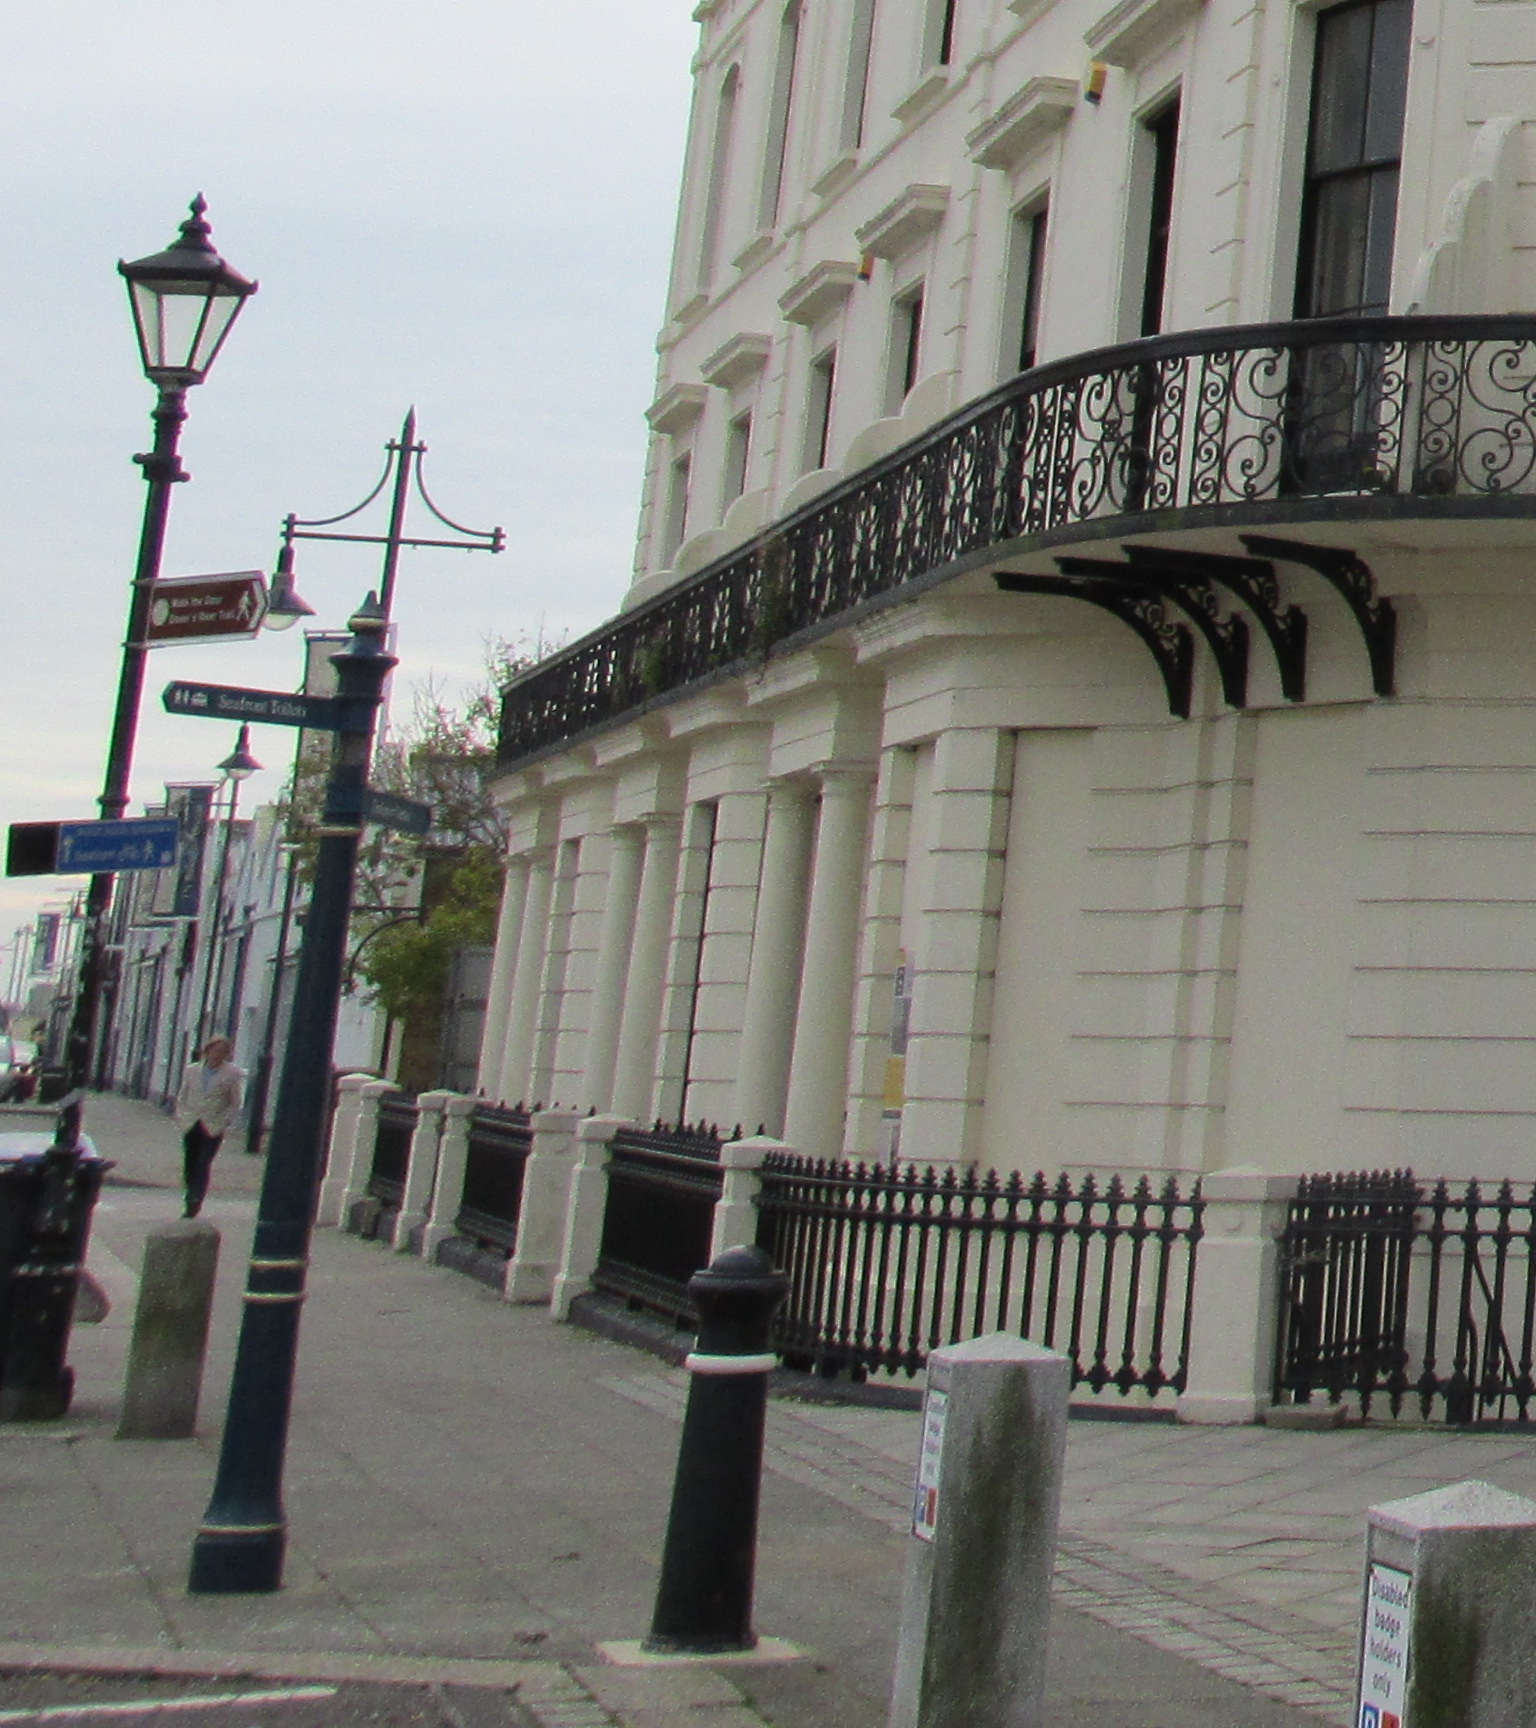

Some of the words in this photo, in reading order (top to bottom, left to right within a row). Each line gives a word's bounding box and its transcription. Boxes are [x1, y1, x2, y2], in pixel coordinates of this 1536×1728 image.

[1375, 1607, 1401, 1639] badge
[1370, 1635, 1402, 1668] holders
[1372, 1672, 1391, 1699] only
